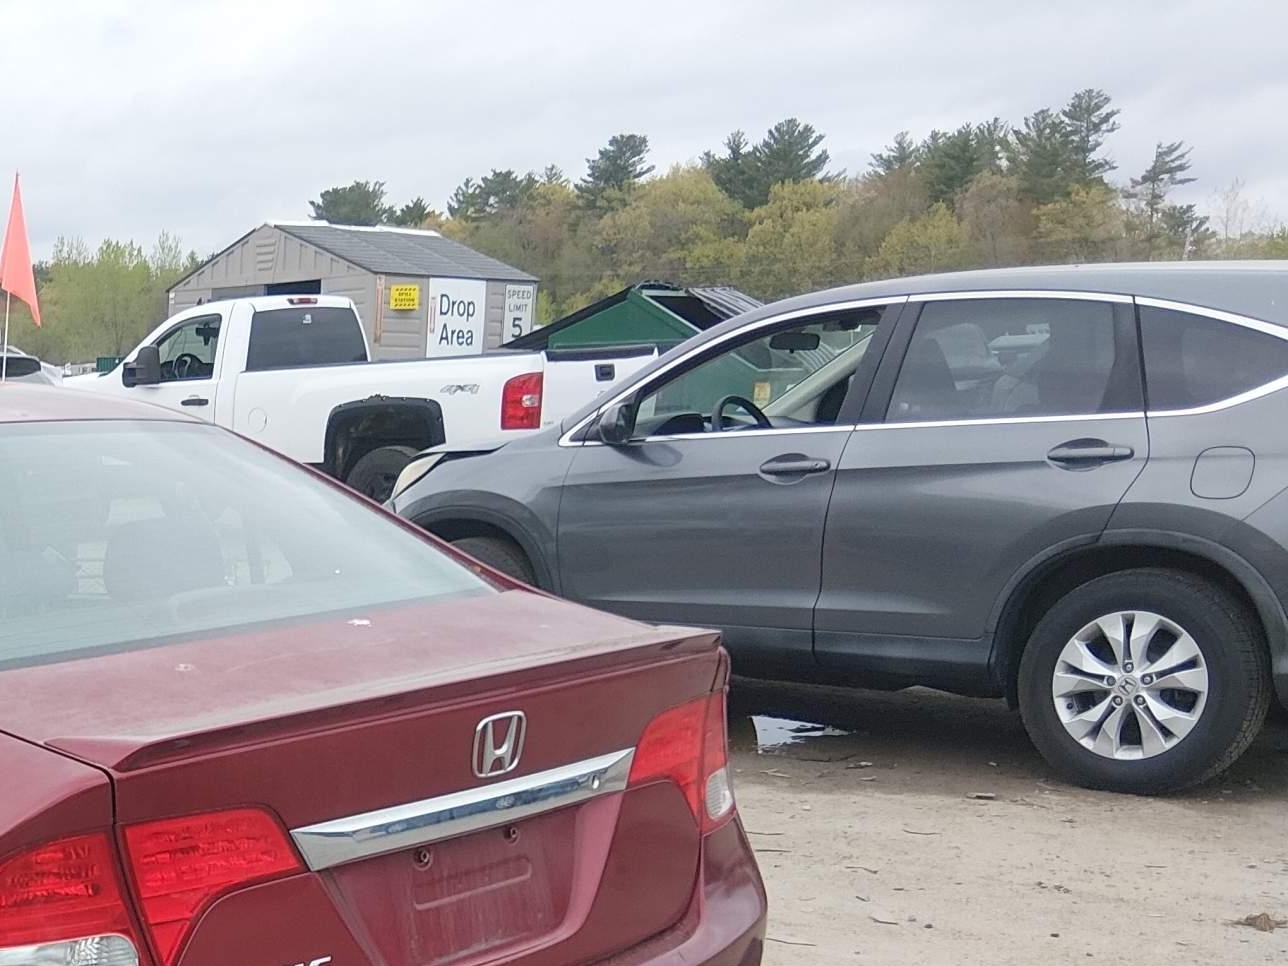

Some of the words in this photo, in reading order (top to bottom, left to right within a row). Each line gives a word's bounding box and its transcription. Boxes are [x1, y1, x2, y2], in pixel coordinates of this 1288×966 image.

[507, 289, 532, 299] SPEED
[440, 294, 476, 322] Drop
[508, 303, 528, 313] LIMIT
[438, 323, 474, 346] Area
[511, 317, 523, 338] 5
